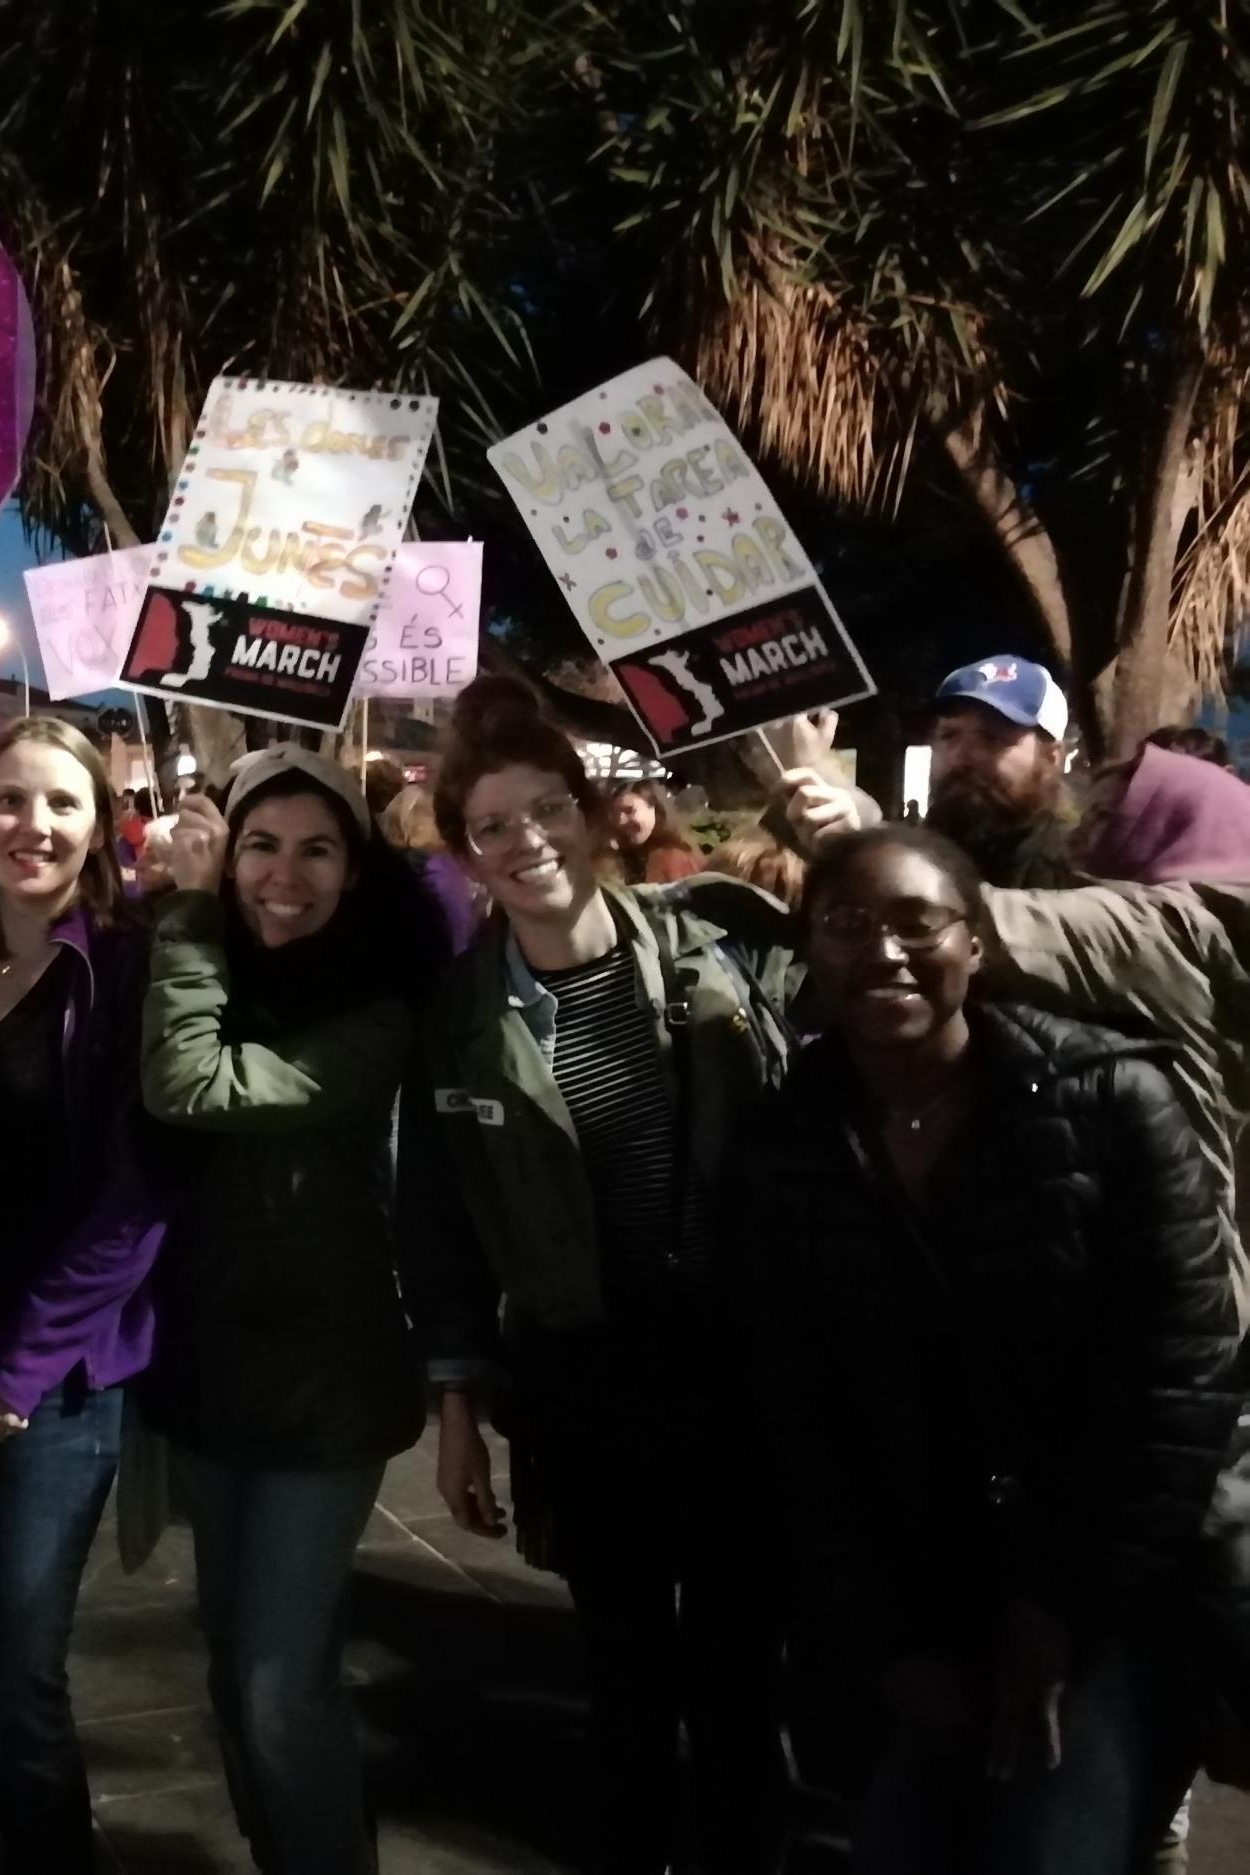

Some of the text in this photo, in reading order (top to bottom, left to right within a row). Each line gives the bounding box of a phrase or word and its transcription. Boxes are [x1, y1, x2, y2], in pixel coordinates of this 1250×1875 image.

[552, 508, 611, 555] LA
[231, 634, 342, 683] MARCH
[719, 626, 829, 686] MARCH
